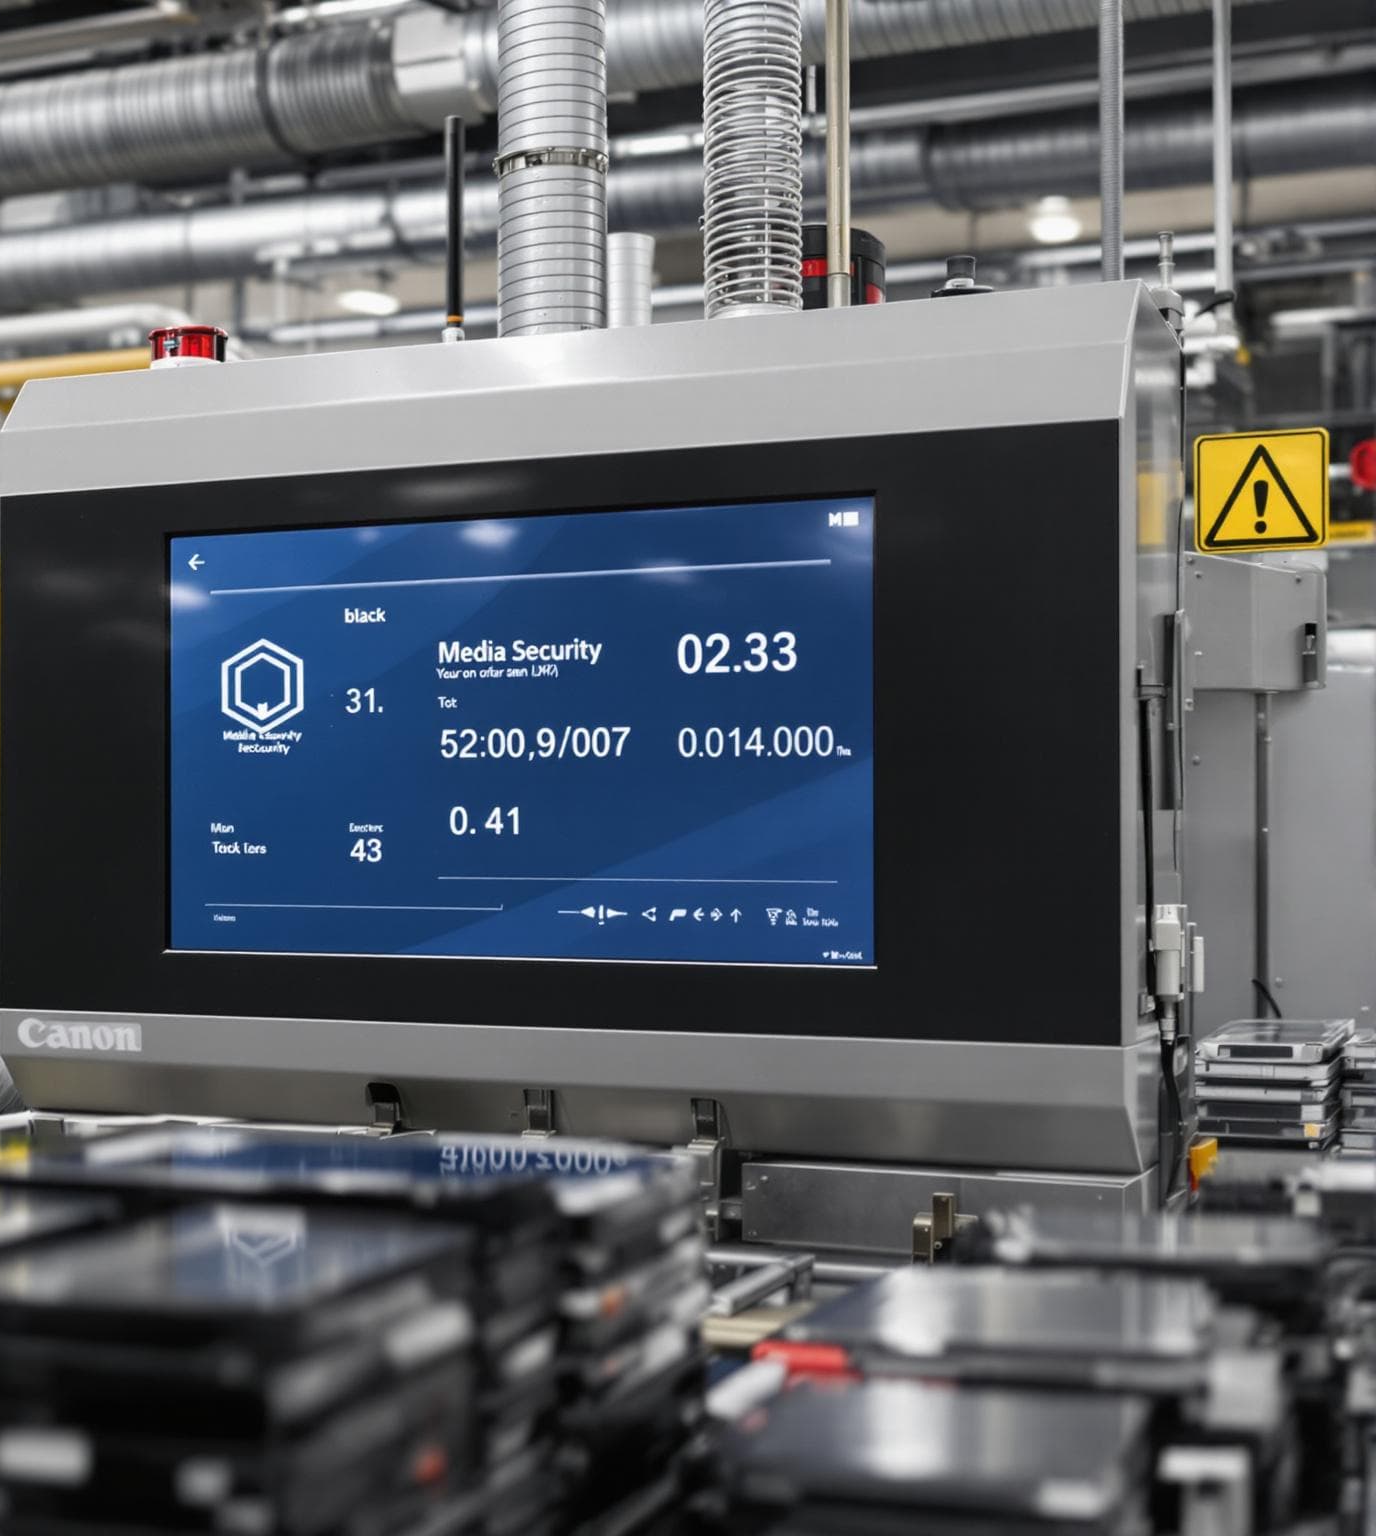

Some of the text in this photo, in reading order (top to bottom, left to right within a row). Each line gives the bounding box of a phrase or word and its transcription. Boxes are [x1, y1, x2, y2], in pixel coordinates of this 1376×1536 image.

[344, 607, 386, 624] black
[438, 638, 603, 665] Media Security
[677, 631, 798, 675] 02.33
[345, 687, 384, 714] 31.
[440, 725, 631, 761] 52:00,9/007
[678, 725, 834, 758] 0.014.000
[350, 838, 382, 863] 43
[17, 1017, 142, 1052] Canon
